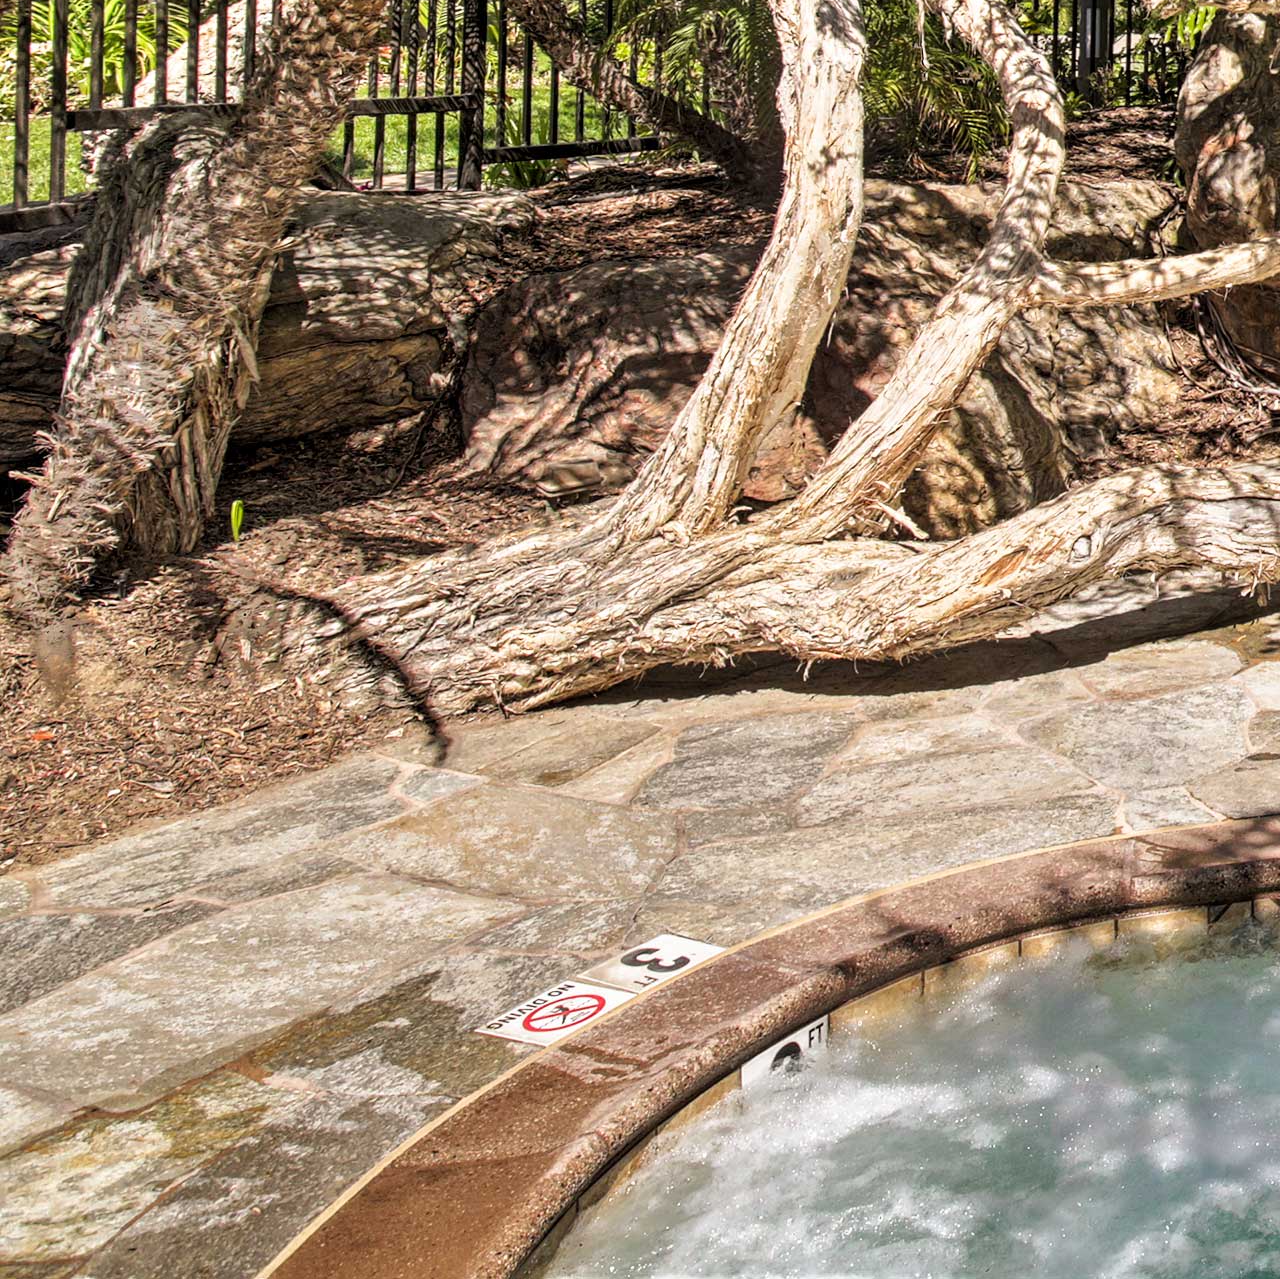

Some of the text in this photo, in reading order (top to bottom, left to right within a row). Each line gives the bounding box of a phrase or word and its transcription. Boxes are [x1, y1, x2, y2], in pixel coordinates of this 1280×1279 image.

[620, 948, 690, 987] 3 FT
[486, 983, 576, 1030] NO DIVING
[808, 1023, 824, 1048] FT
